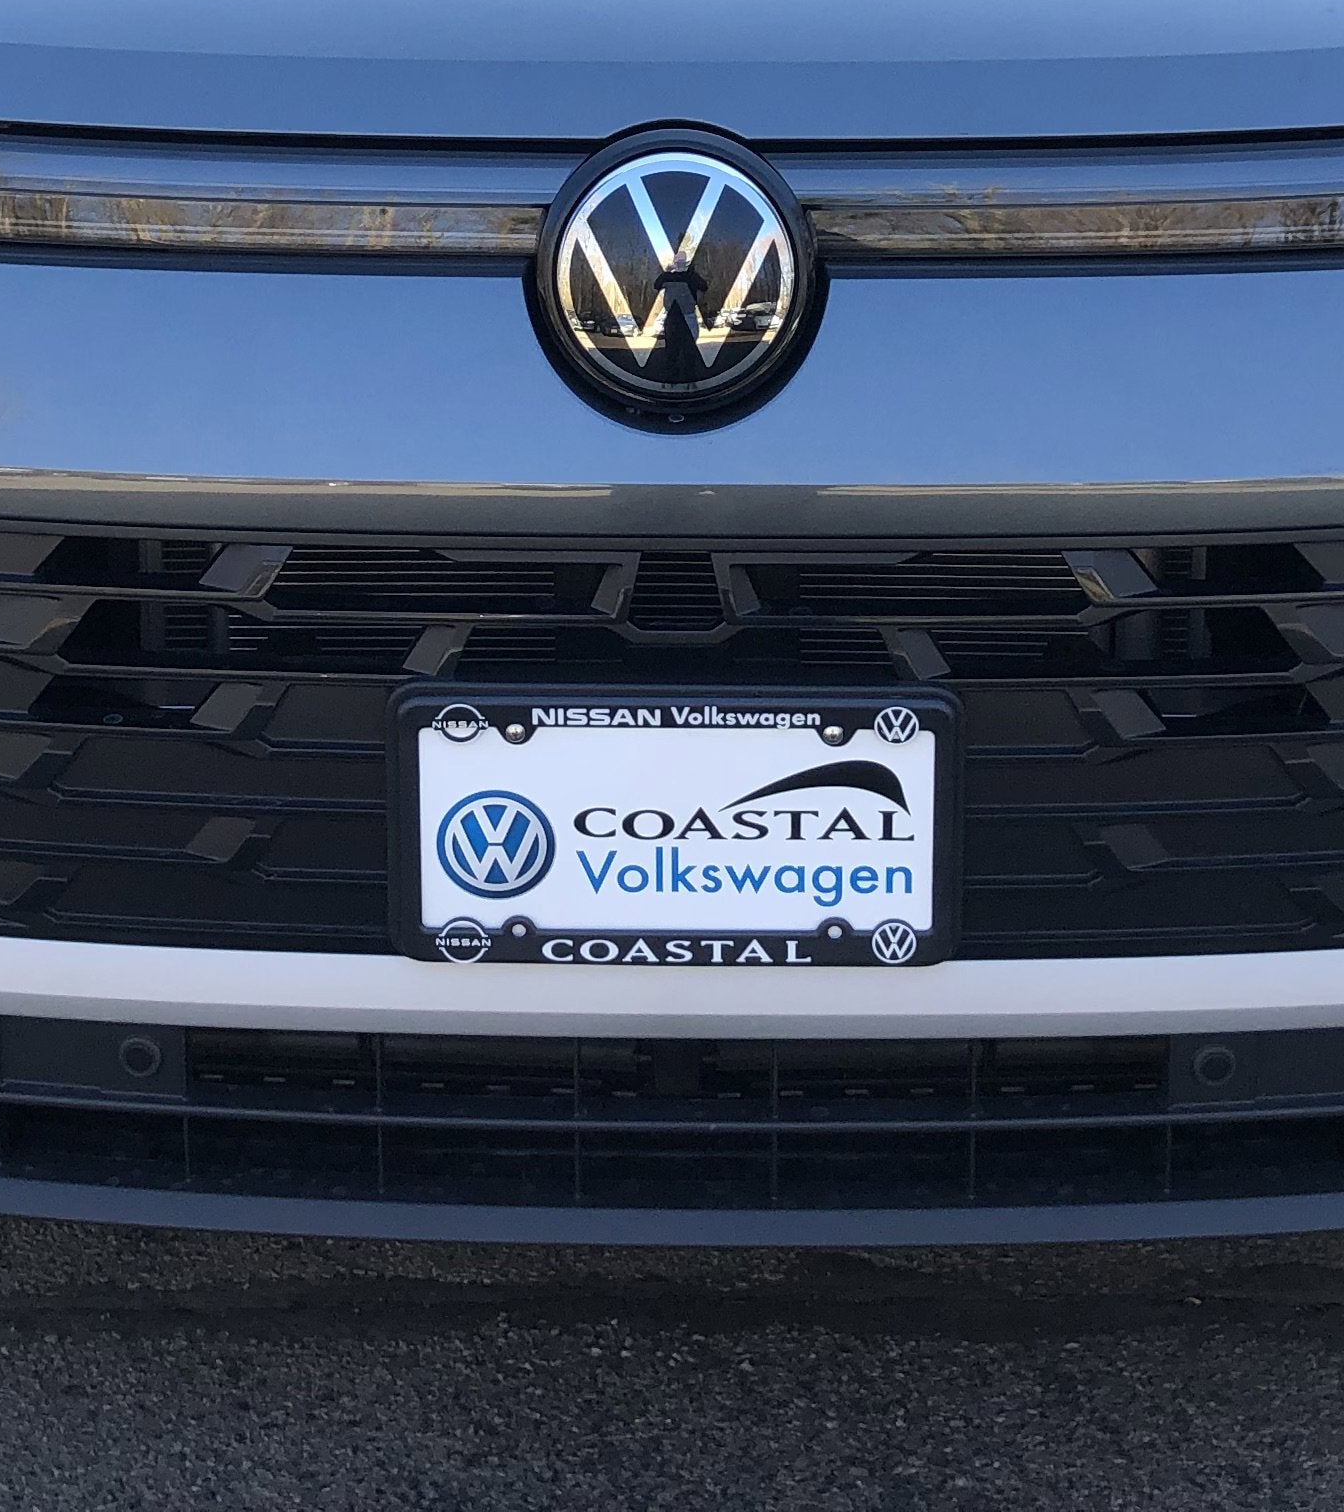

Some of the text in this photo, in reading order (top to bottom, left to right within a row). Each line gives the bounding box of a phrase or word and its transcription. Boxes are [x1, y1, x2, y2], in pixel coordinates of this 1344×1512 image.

[431, 718, 490, 730] NISSAN
[531, 706, 821, 729] NISSAN Volkswagen
[572, 806, 915, 841] COASTAL
[575, 846, 913, 907] Volkswagen
[435, 936, 492, 948] NISSAN
[541, 938, 813, 964] COASTAL
